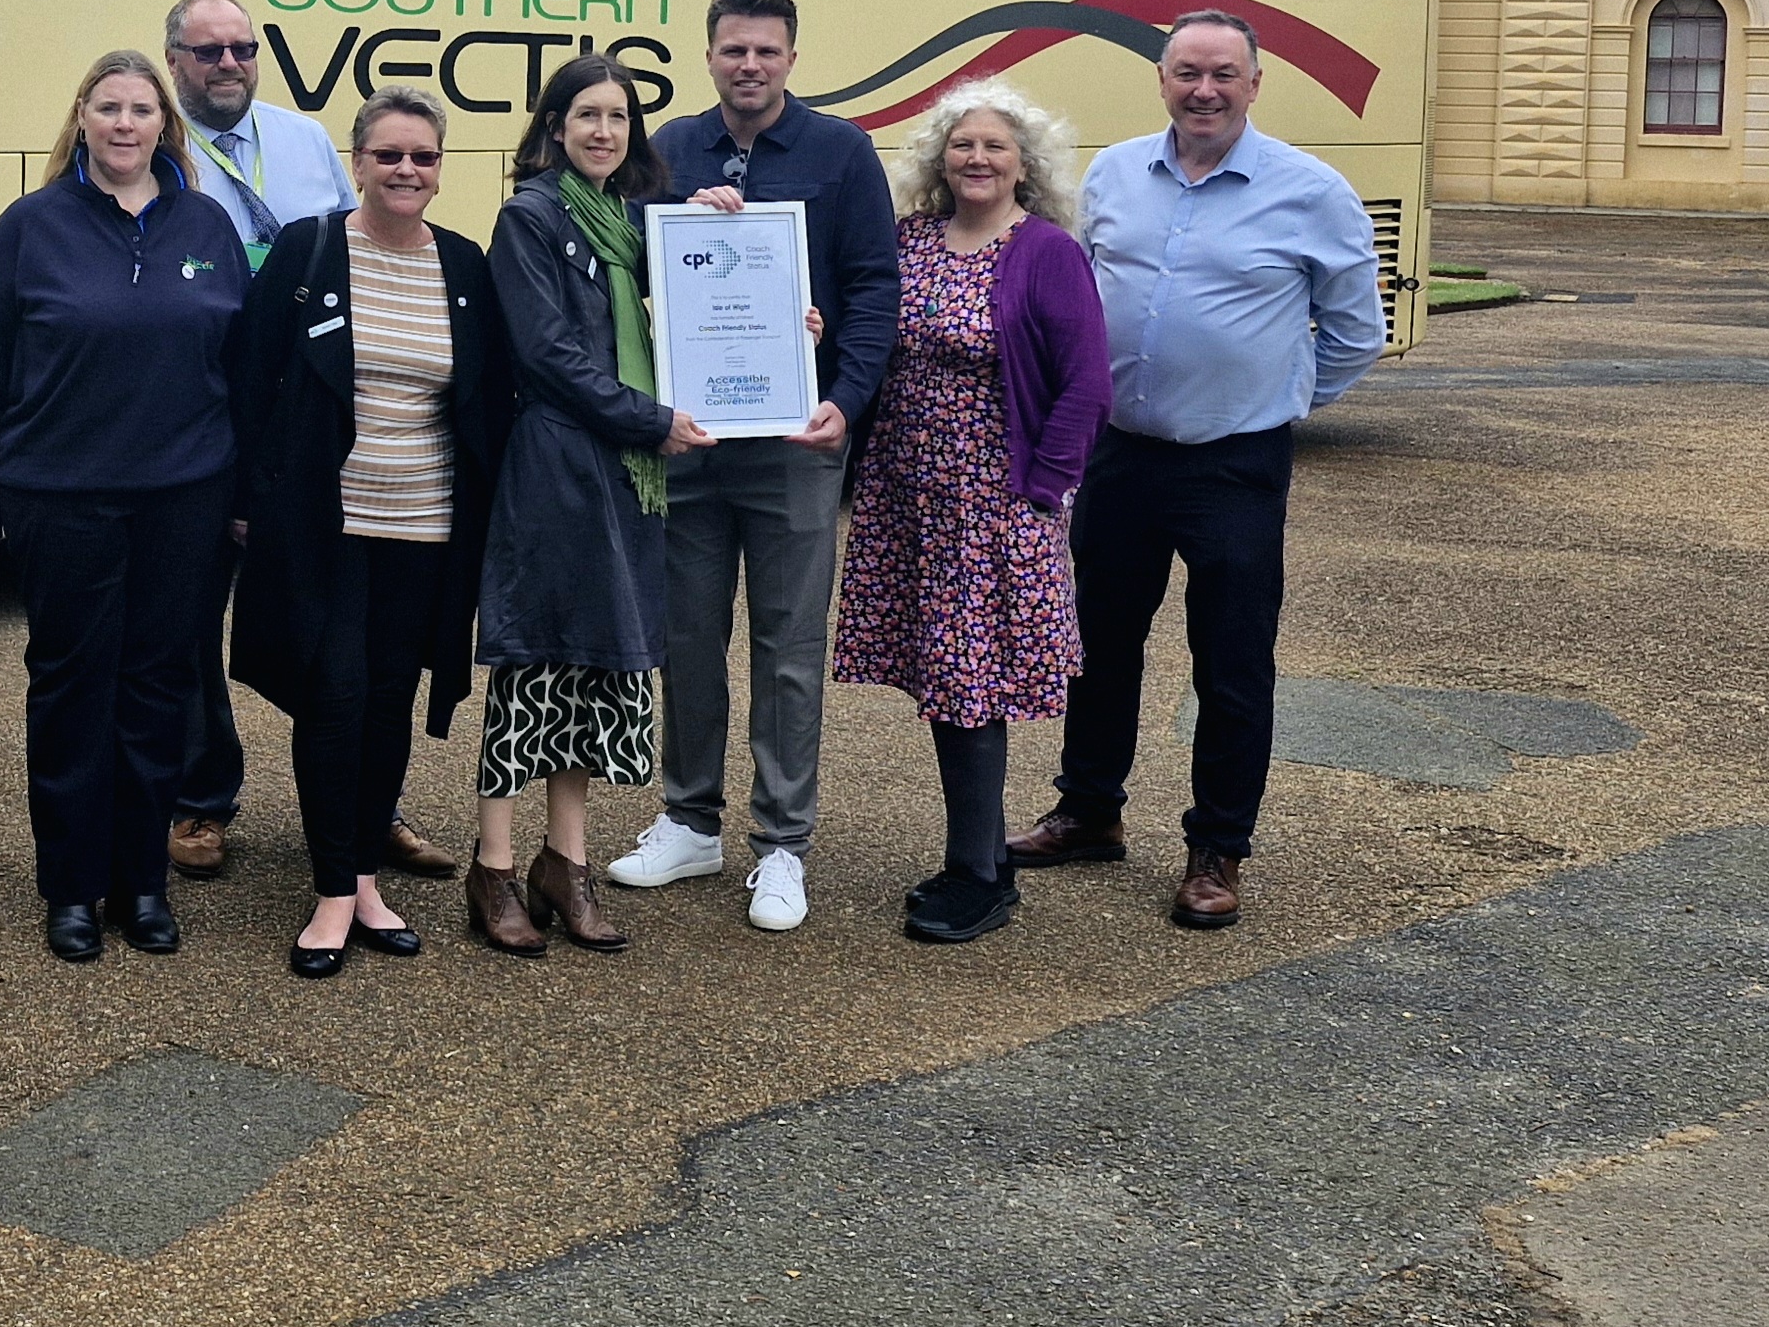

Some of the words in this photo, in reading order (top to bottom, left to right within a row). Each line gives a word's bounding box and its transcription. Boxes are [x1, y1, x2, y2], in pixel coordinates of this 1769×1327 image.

[262, 23, 674, 114] VECTS
[682, 250, 714, 270] cpt
[711, 384, 771, 393] Eco-friendly
[705, 397, 765, 406] Convenient
